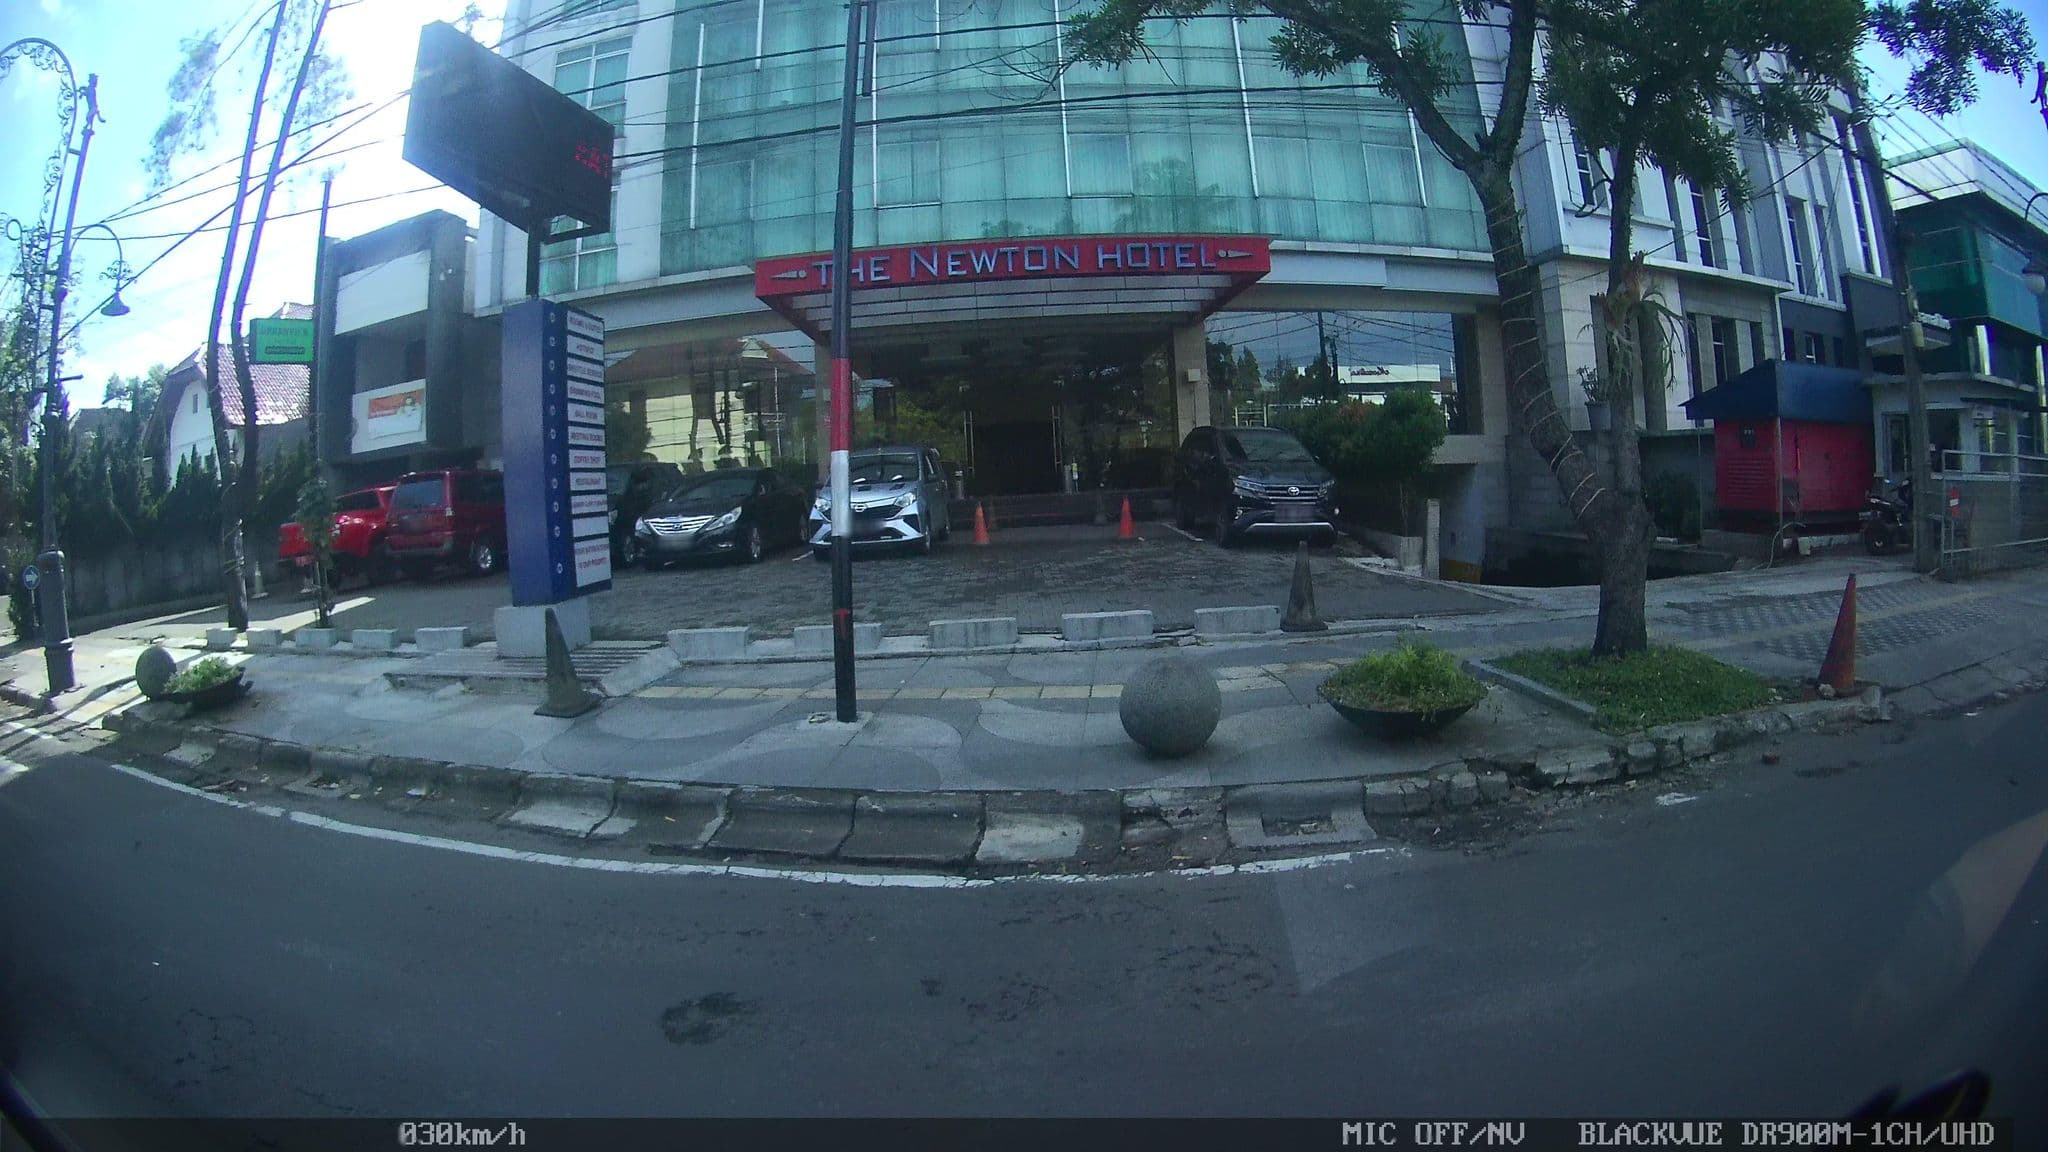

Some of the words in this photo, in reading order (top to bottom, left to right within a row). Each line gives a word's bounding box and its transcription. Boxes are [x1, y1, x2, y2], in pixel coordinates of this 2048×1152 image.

[812, 255, 890, 287] THE
[910, 244, 1080, 278] NEWTON
[1097, 242, 1217, 269] HOTEL
